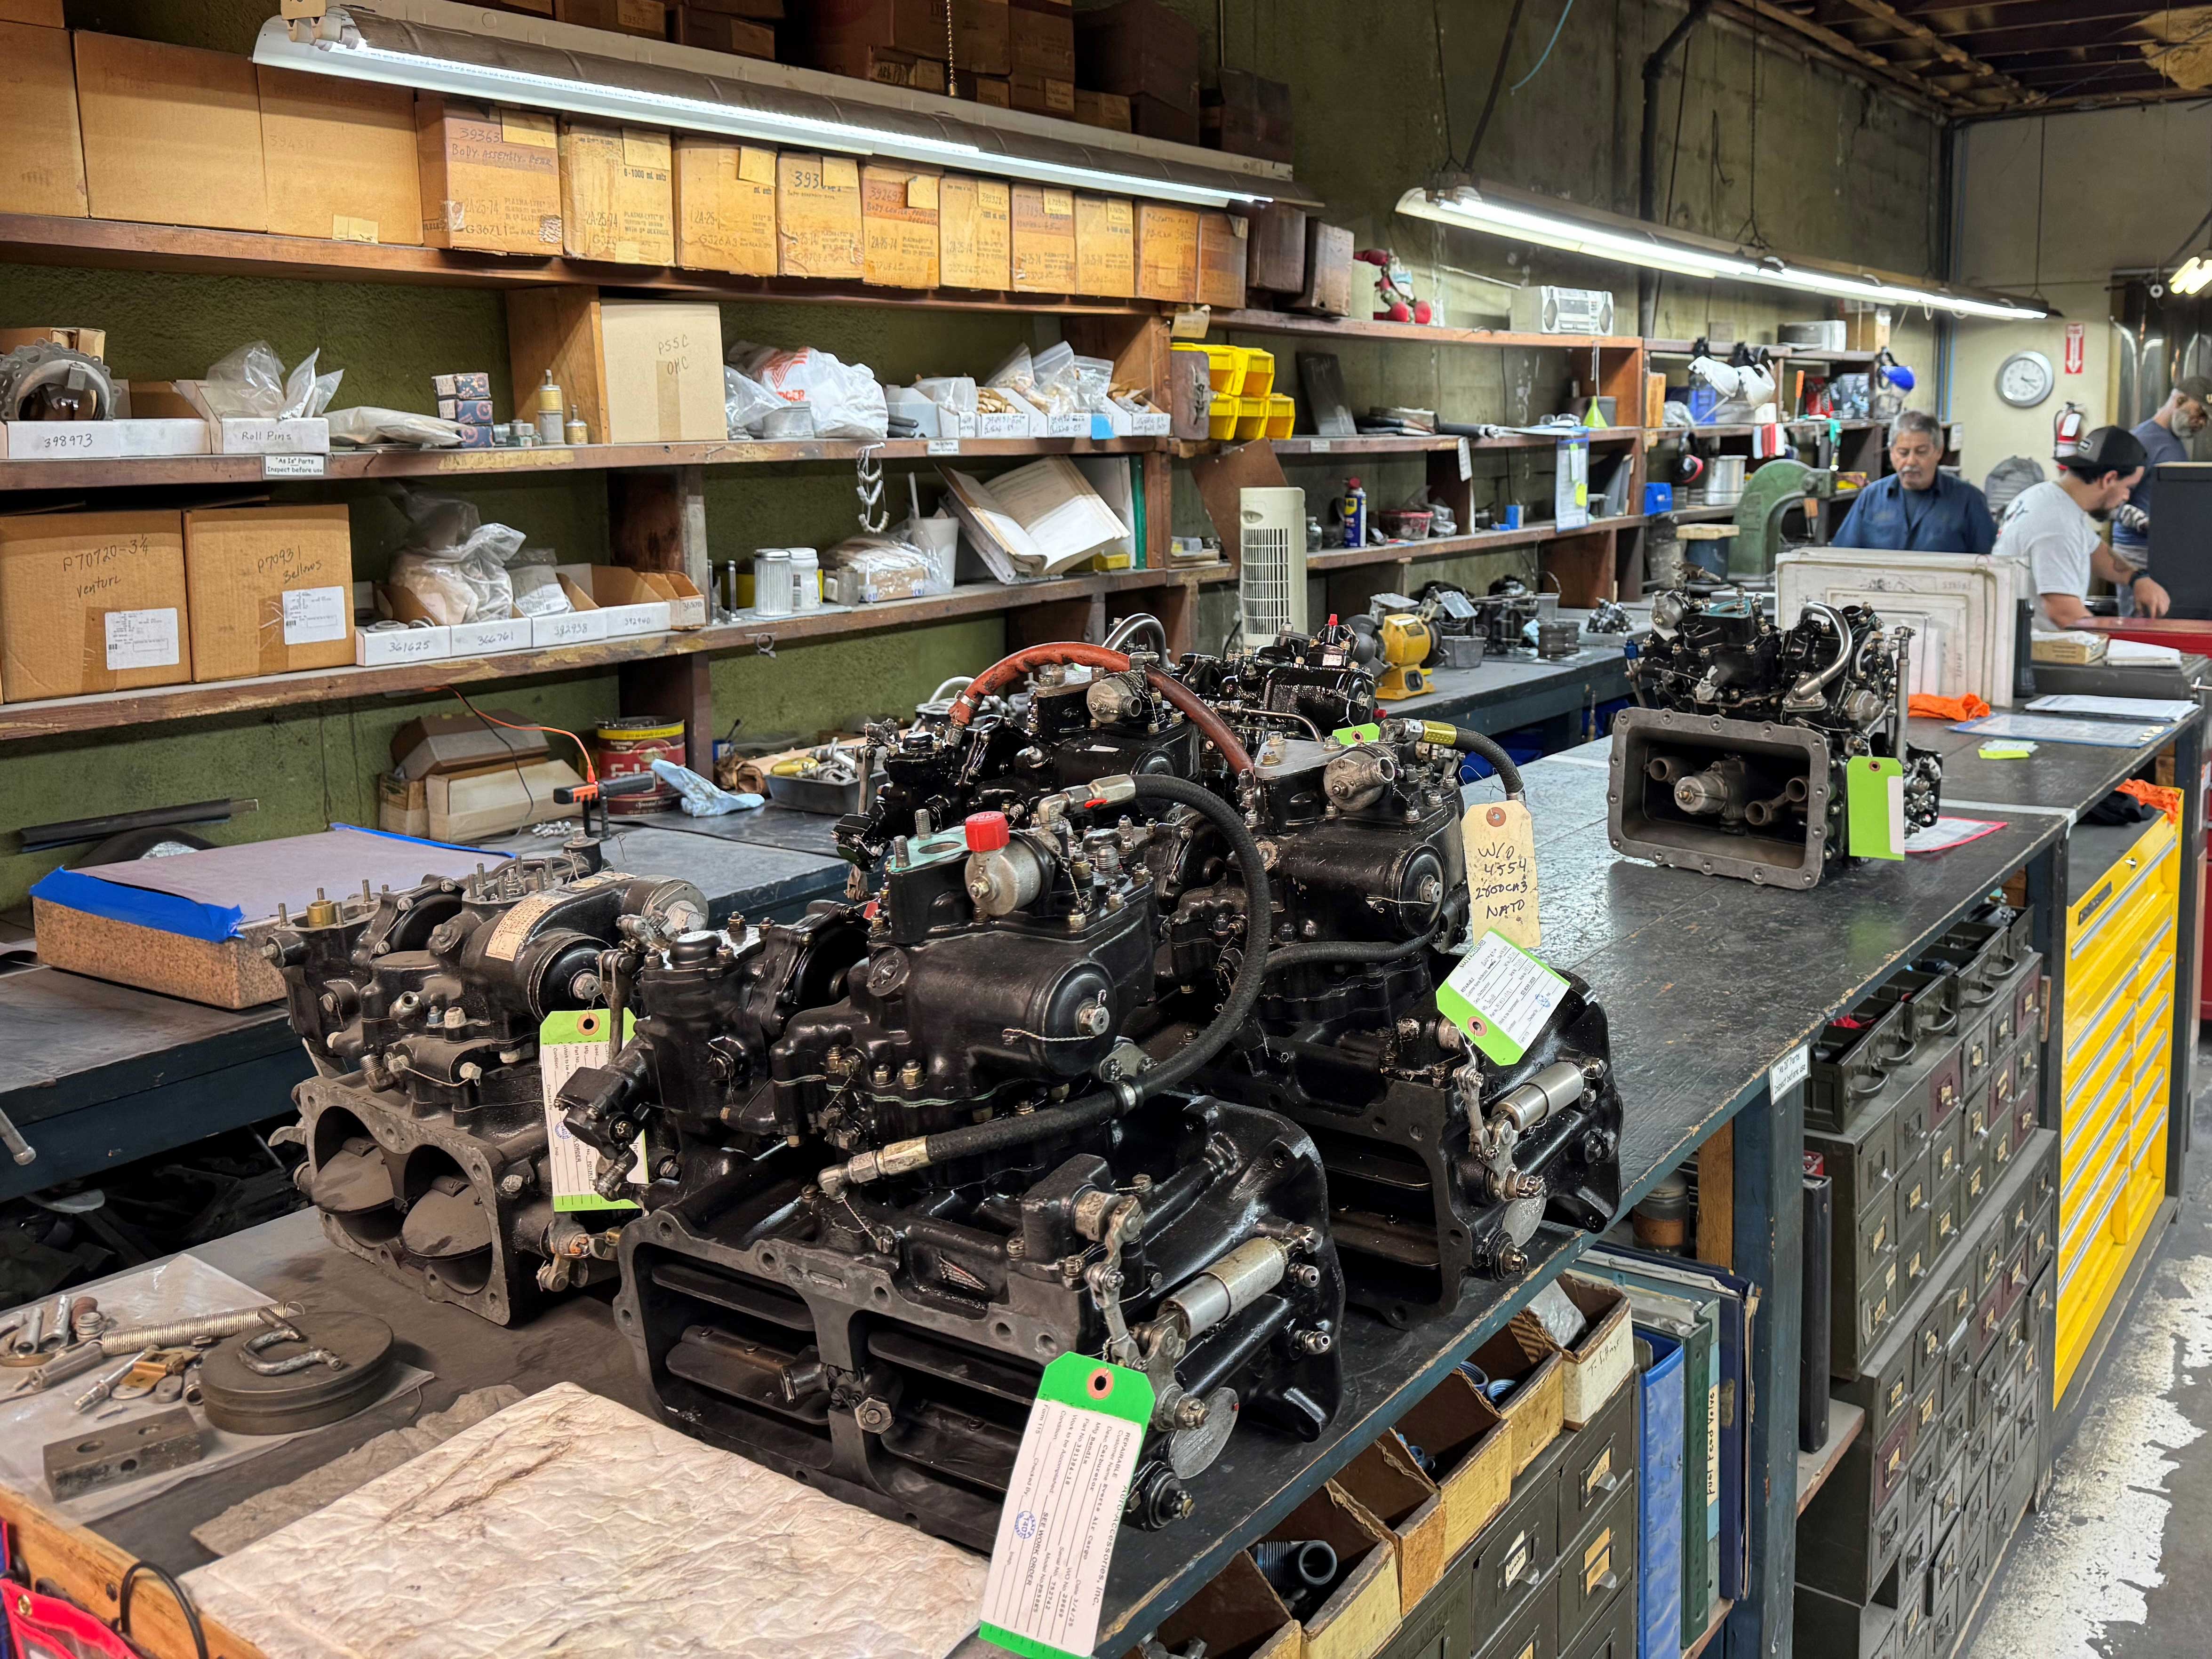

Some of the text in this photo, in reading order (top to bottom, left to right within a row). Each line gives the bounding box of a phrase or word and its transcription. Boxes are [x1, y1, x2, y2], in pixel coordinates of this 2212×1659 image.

[44, 433, 93, 448] 398973
[241, 431, 292, 442] Roll Pins
[267, 465, 290, 474] Inspect
[389, 640, 430, 652] 361625
[477, 631, 514, 646] 366761
[1484, 859, 1528, 876] 4554
[1486, 900, 1525, 919] NATO
[1038, 1404, 1048, 1421] Form
[1068, 1414, 1078, 1431] Work
[1080, 1418, 1089, 1432] Part
[1062, 1439, 1070, 1448] be
[1082, 1421, 1101, 1465] Mfg Bendix
[1109, 1429, 1123, 1461] Customer
[1111, 1431, 1131, 1479] REPAIRABLE
[1026, 1457, 1039, 1486] Checked
[1089, 1444, 1108, 1492] Carburetor
[1103, 1461, 1113, 1481] Name
[1090, 1516, 1099, 1531] Air
[1025, 1511, 1049, 1586] SEE WORK ORDER
[1055, 1546, 1065, 1565] Serial
[1081, 1534, 1094, 1561] Cargo
[1041, 1551, 1051, 1573] Model
